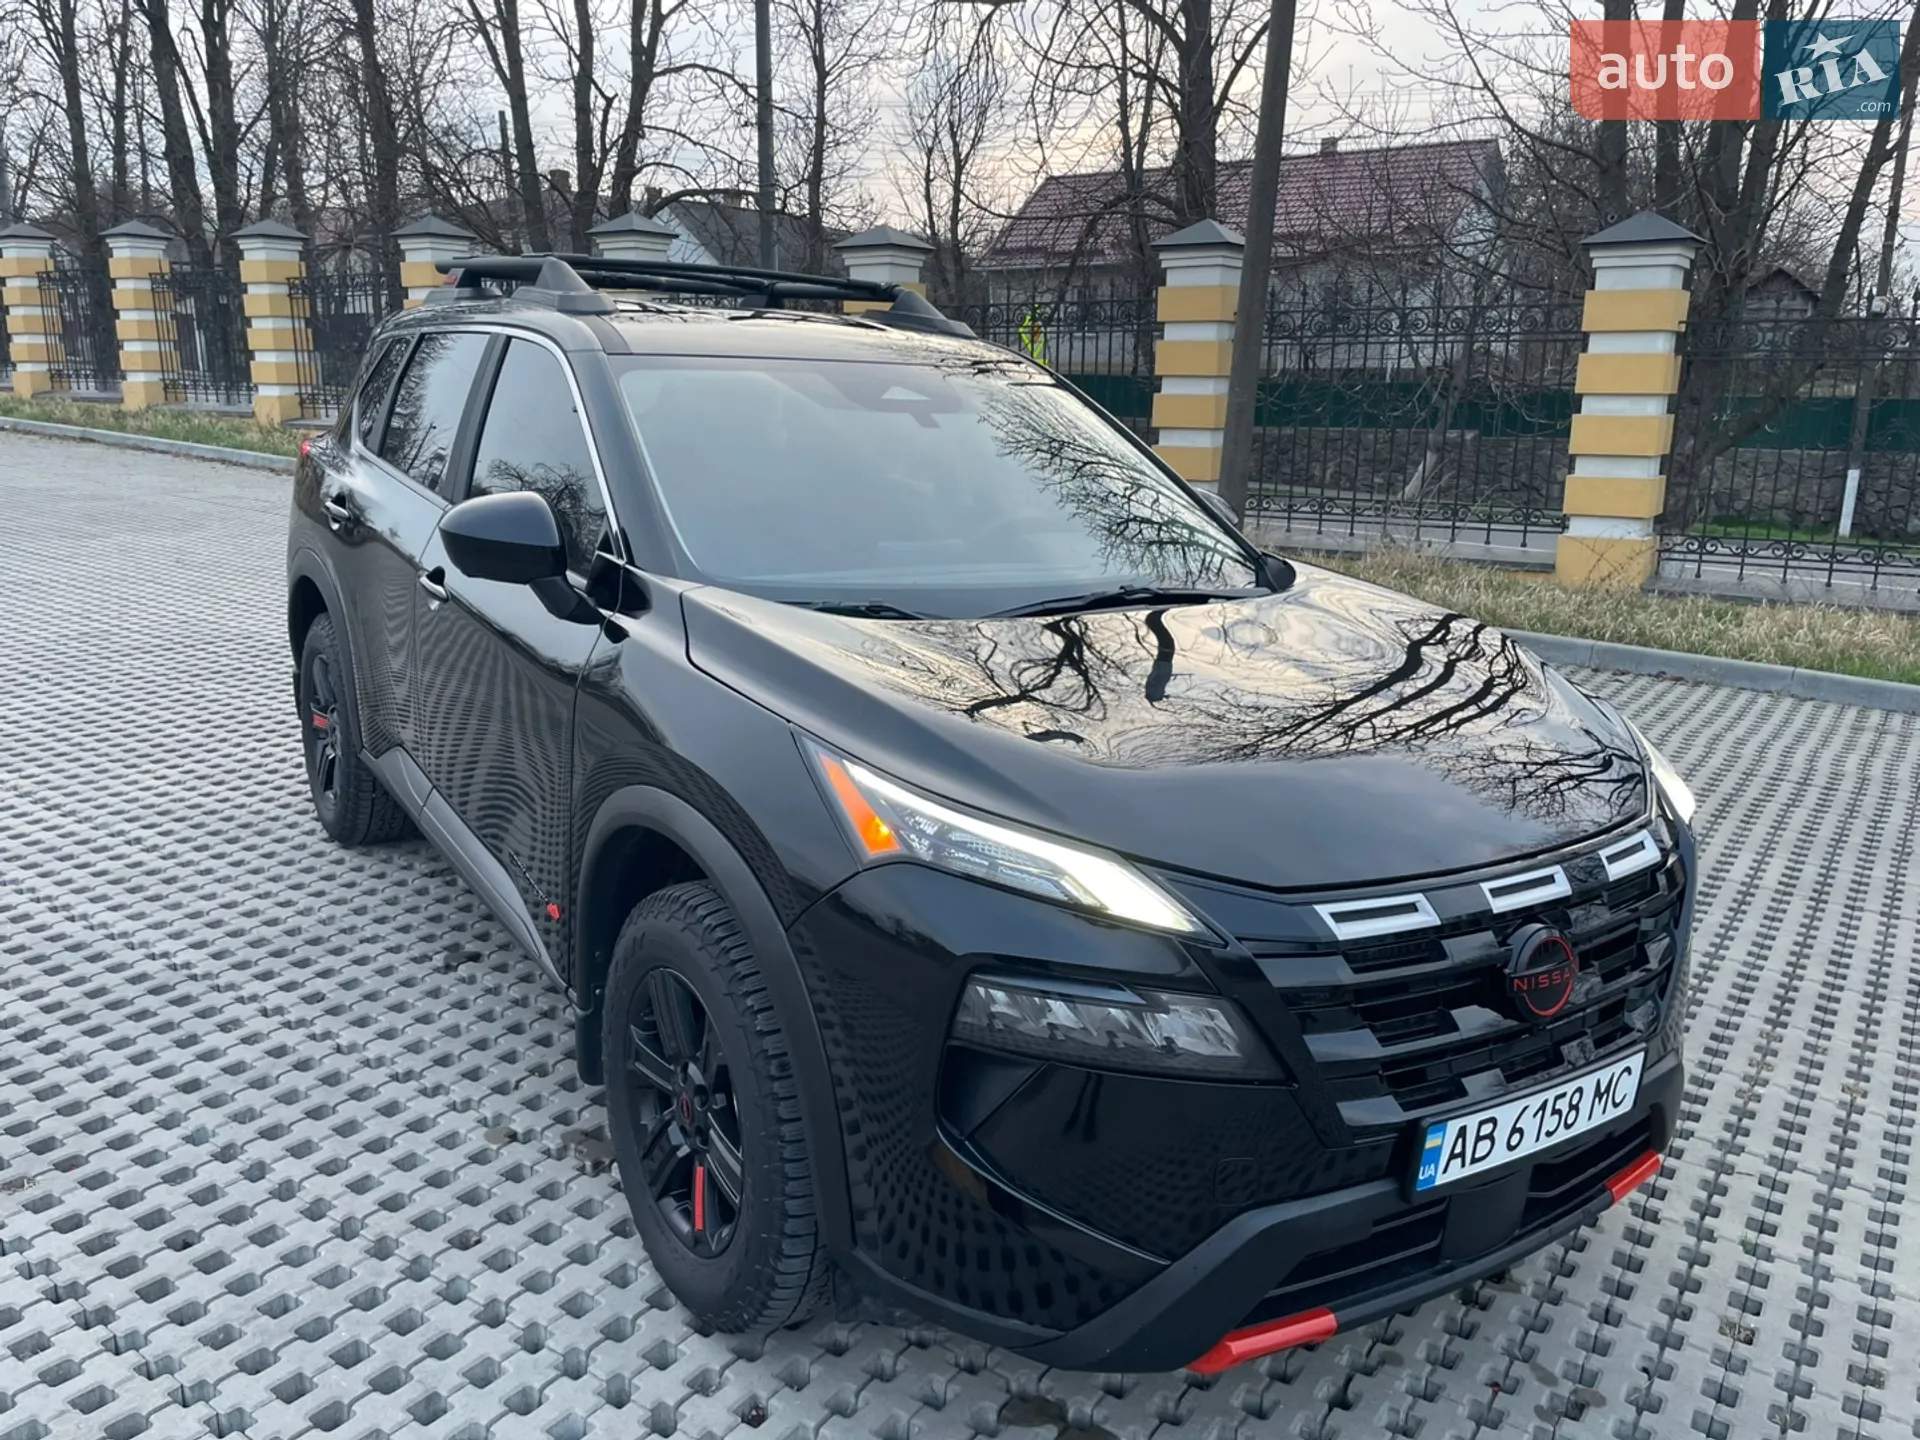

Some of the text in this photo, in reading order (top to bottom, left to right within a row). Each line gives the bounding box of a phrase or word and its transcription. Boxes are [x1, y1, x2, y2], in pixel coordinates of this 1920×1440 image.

[1442, 1066, 1632, 1174] AB 6158 MC
[1419, 1163, 1435, 1180] UA
